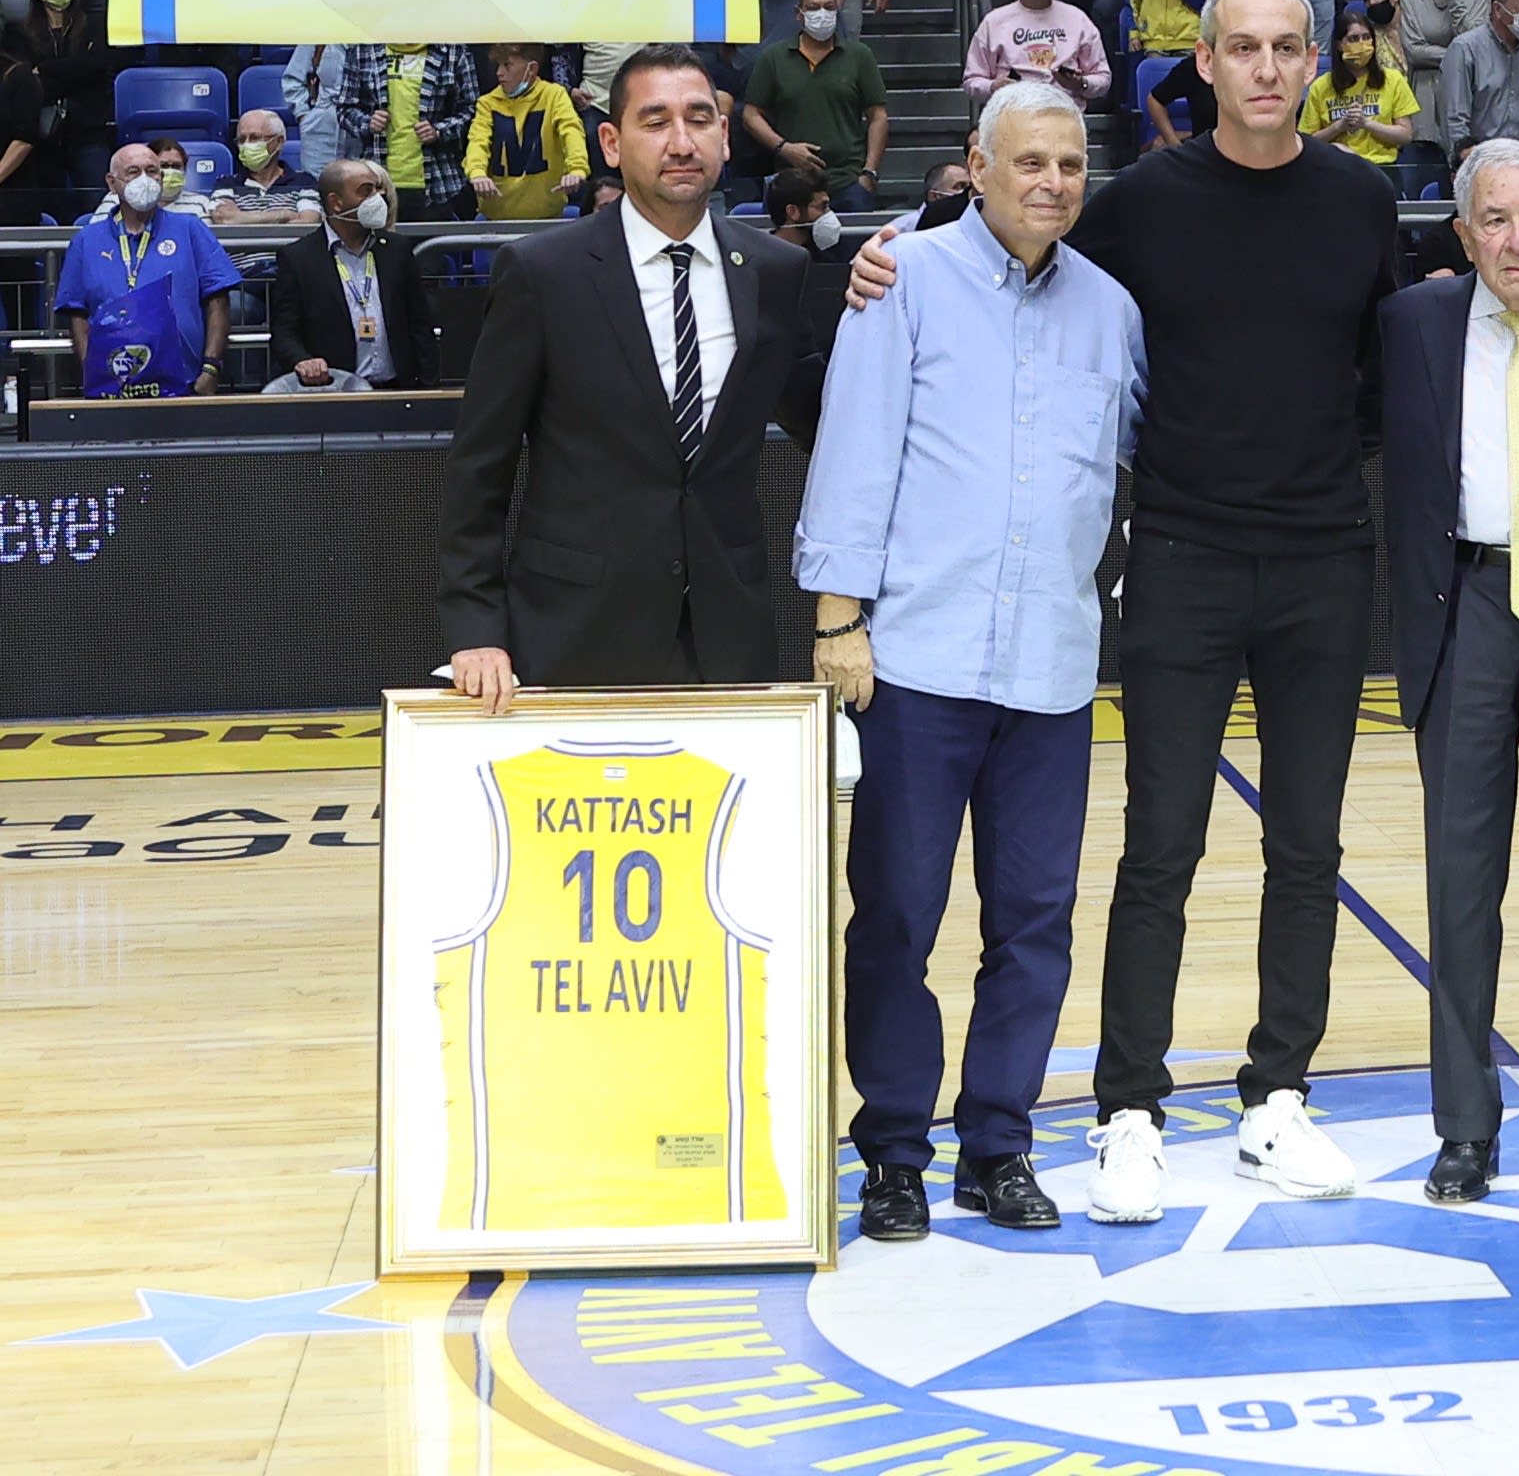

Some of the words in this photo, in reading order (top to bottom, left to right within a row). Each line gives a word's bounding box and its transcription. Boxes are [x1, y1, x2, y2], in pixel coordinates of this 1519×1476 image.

[1366, 94, 1380, 104] TLV
[490, 109, 549, 178] M
[536, 797, 693, 835] KATTASH
[562, 849, 663, 944] 10
[530, 959, 592, 1013] TEL
[605, 959, 692, 1013] AVIV
[576, 1287, 787, 1365] AVIV
[634, 1363, 904, 1449] TEL
[1158, 1390, 1474, 1437] 1932
